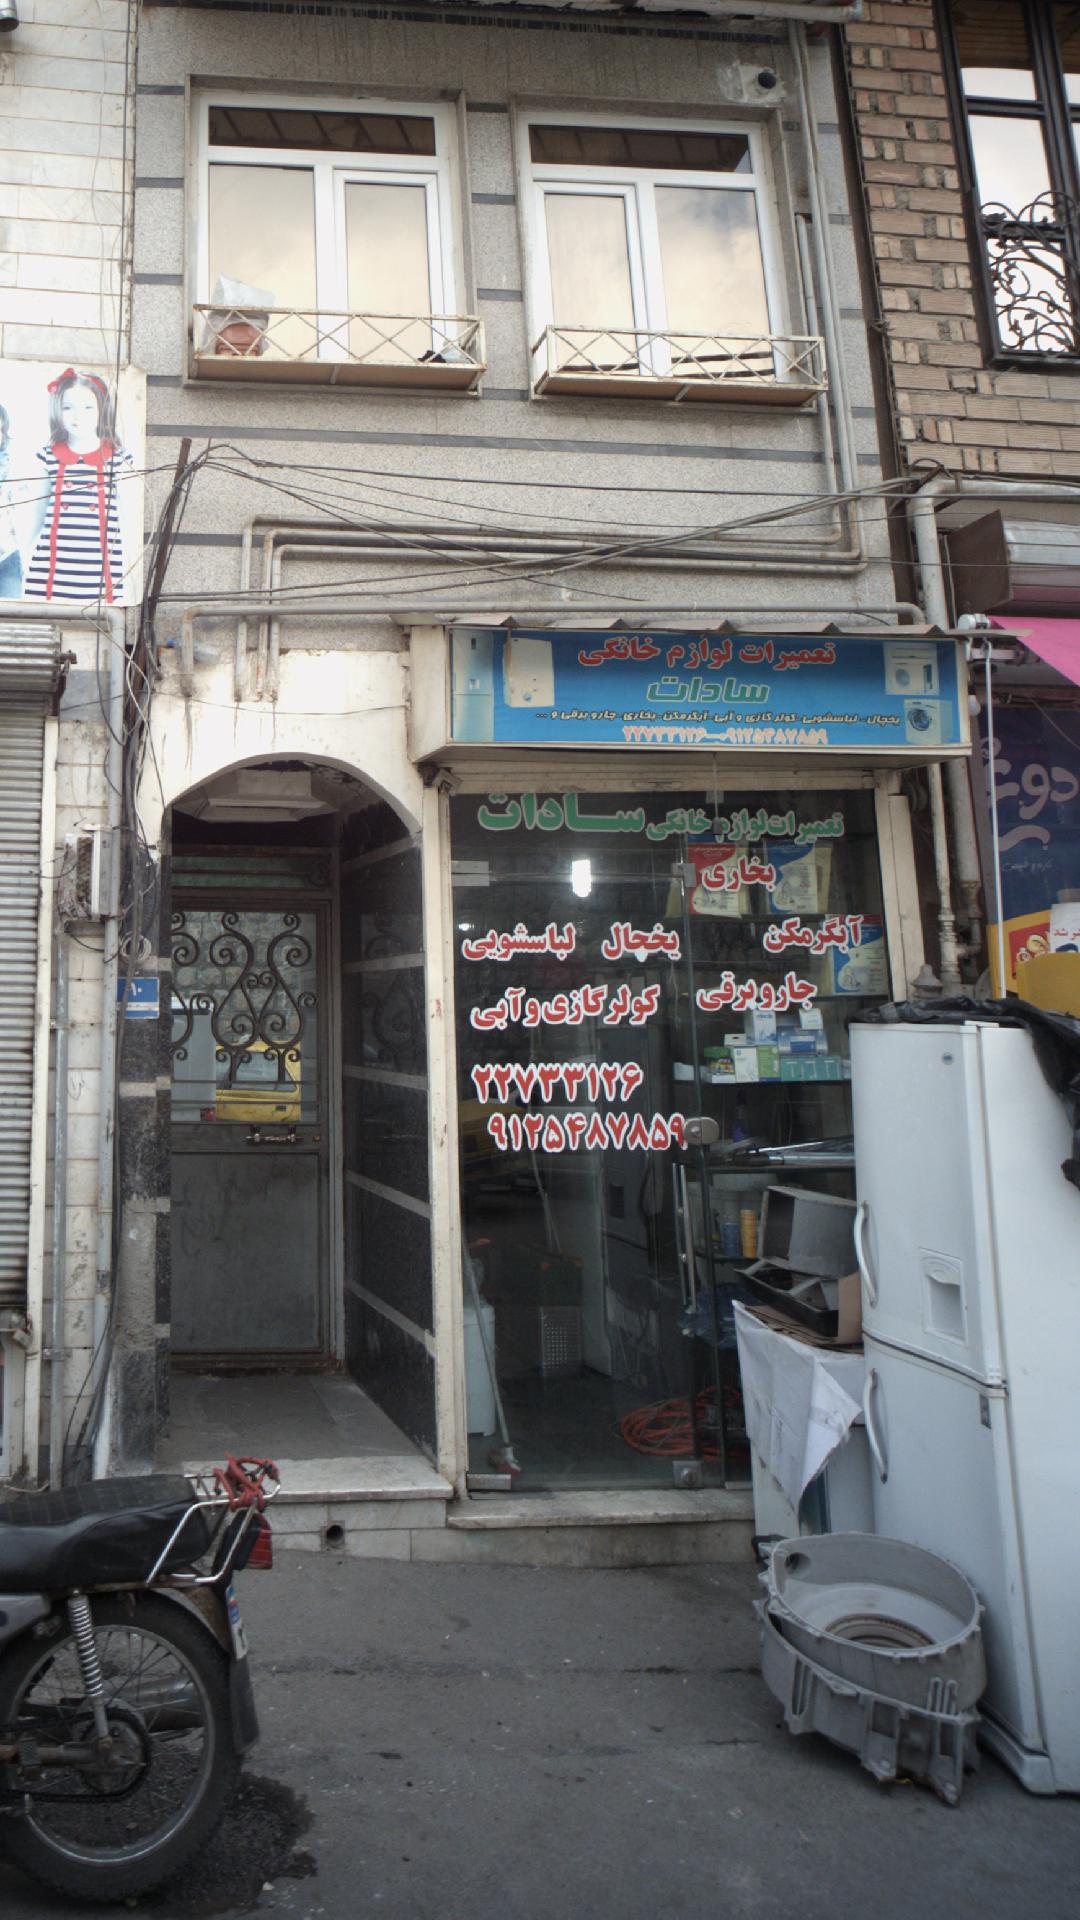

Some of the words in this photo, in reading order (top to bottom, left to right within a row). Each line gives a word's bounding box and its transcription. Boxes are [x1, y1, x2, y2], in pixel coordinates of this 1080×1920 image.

[578, 636, 661, 667] خانگی
[666, 638, 733, 669] لوازم
[739, 640, 836, 670] تعمیرات
[646, 676, 770, 703] سادات
[551, 711, 558, 719] و
[622, 710, 657, 721] بخاری
[736, 714, 742, 722] و
[745, 712, 772, 723] گازی
[866, 714, 900, 726] یخچال
[477, 792, 646, 832] سادات
[646, 808, 712, 841] خانگی
[767, 810, 845, 844] تعمیرات
[702, 855, 776, 892] بخاری
[462, 922, 576, 961] لباسشویی
[601, 921, 682, 962] یخچال
[763, 914, 864, 954] آبگرمکن
[470, 986, 526, 1030] آبی
[541, 984, 608, 1024] گازی
[603, 984, 660, 1025] کولر
[696, 970, 757, 1011] برقی
[759, 971, 818, 1010] جارو
[522, 998, 542, 1027] و
[471, 1062, 644, 1104] ۲۲۷۳۳۱۲۶
[488, 1112, 688, 1152] ۹۱۲۵۴۸۷۸۵۹
